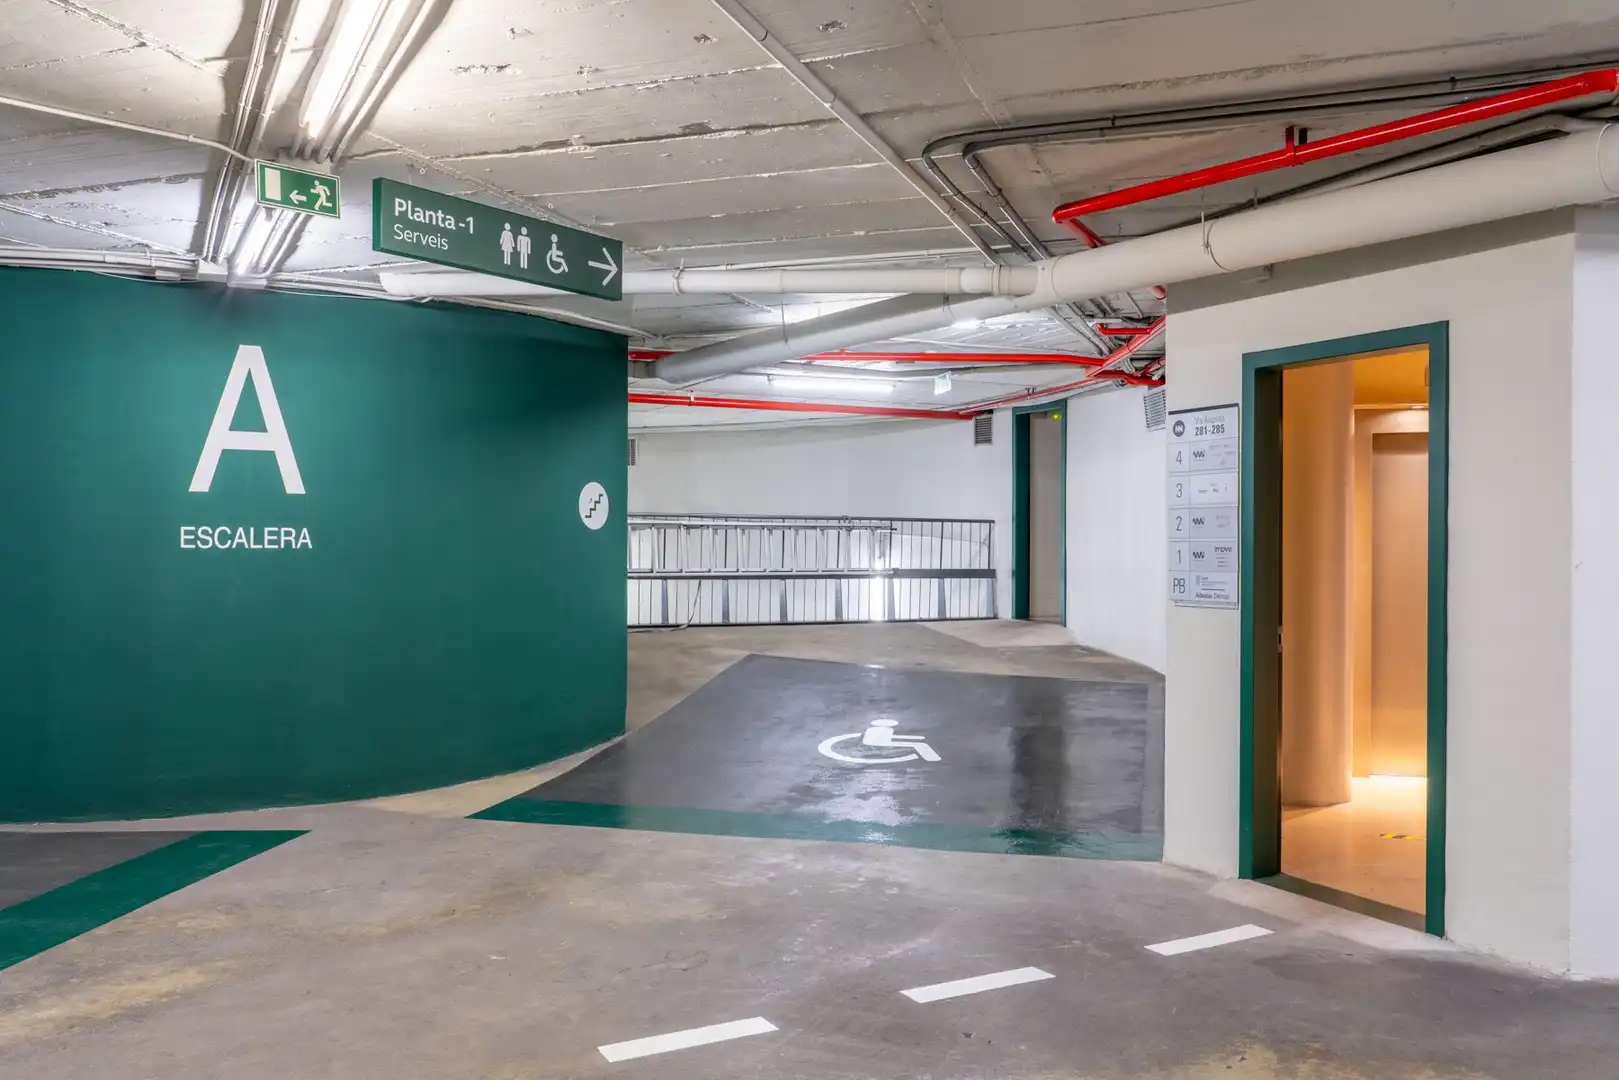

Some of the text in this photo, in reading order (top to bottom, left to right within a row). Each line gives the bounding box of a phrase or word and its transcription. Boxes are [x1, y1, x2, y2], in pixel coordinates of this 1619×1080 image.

[394, 197, 456, 231] Planta
[393, 223, 449, 250] Serveis
[188, 344, 306, 495] A
[1194, 423, 1225, 436] 281-285
[1175, 450, 1182, 465] 4
[1175, 482, 1183, 499] 3
[1175, 515, 1183, 532] 2
[179, 526, 313, 549] ESCALERA
[1176, 548, 1182, 565] 1
[1172, 577, 1186, 595] PB
